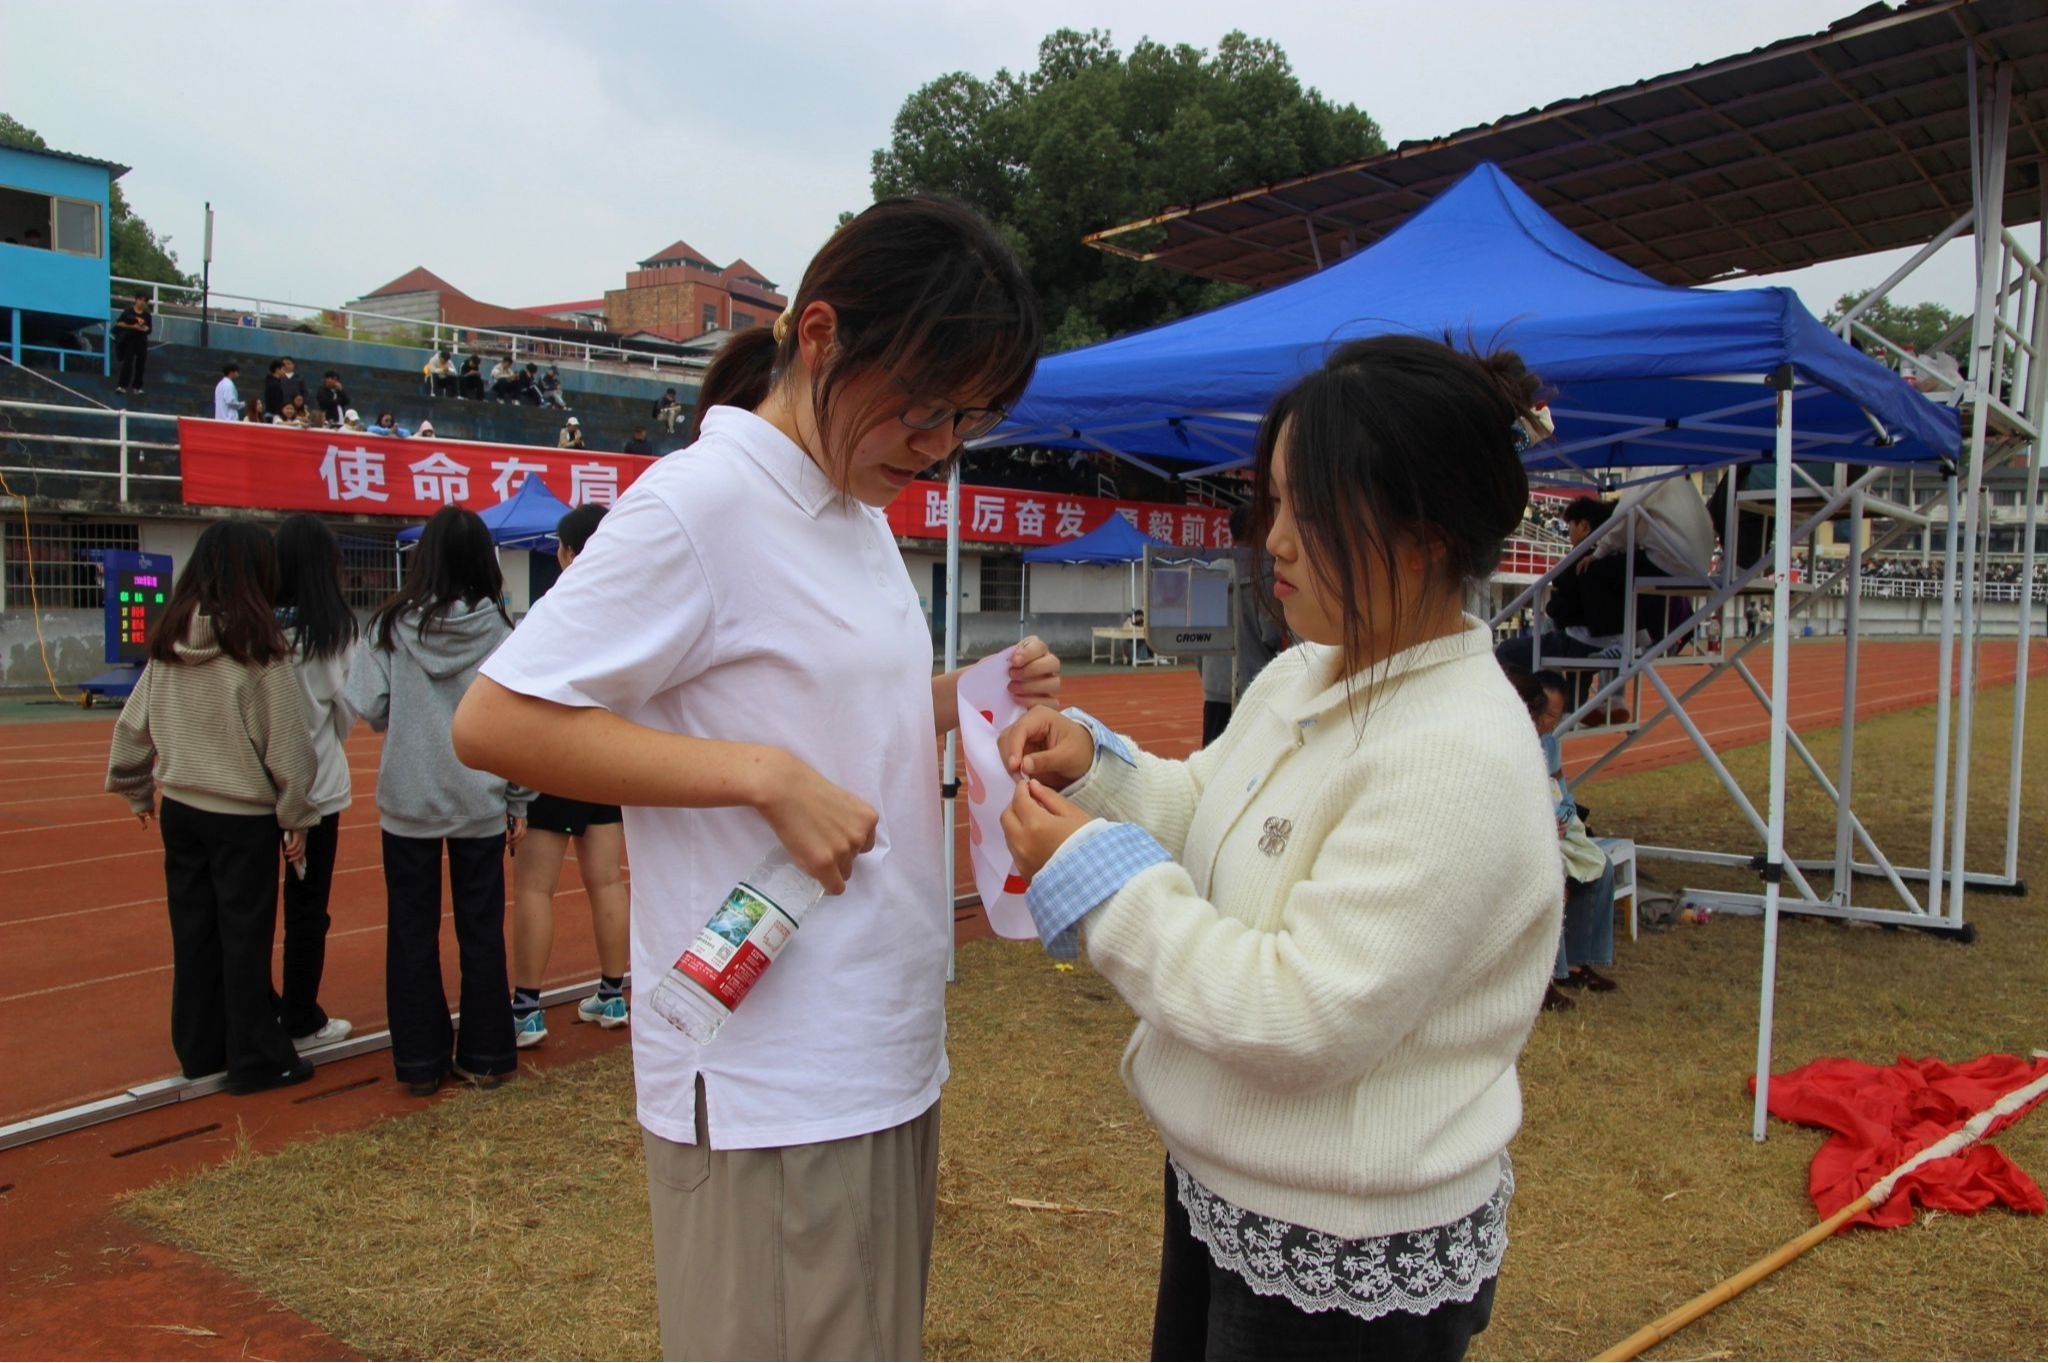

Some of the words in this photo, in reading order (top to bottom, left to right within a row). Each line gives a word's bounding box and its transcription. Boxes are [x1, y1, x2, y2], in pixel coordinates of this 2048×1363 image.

[319, 444, 618, 507] 使命在肩
[1176, 633, 1211, 643] CROWN
